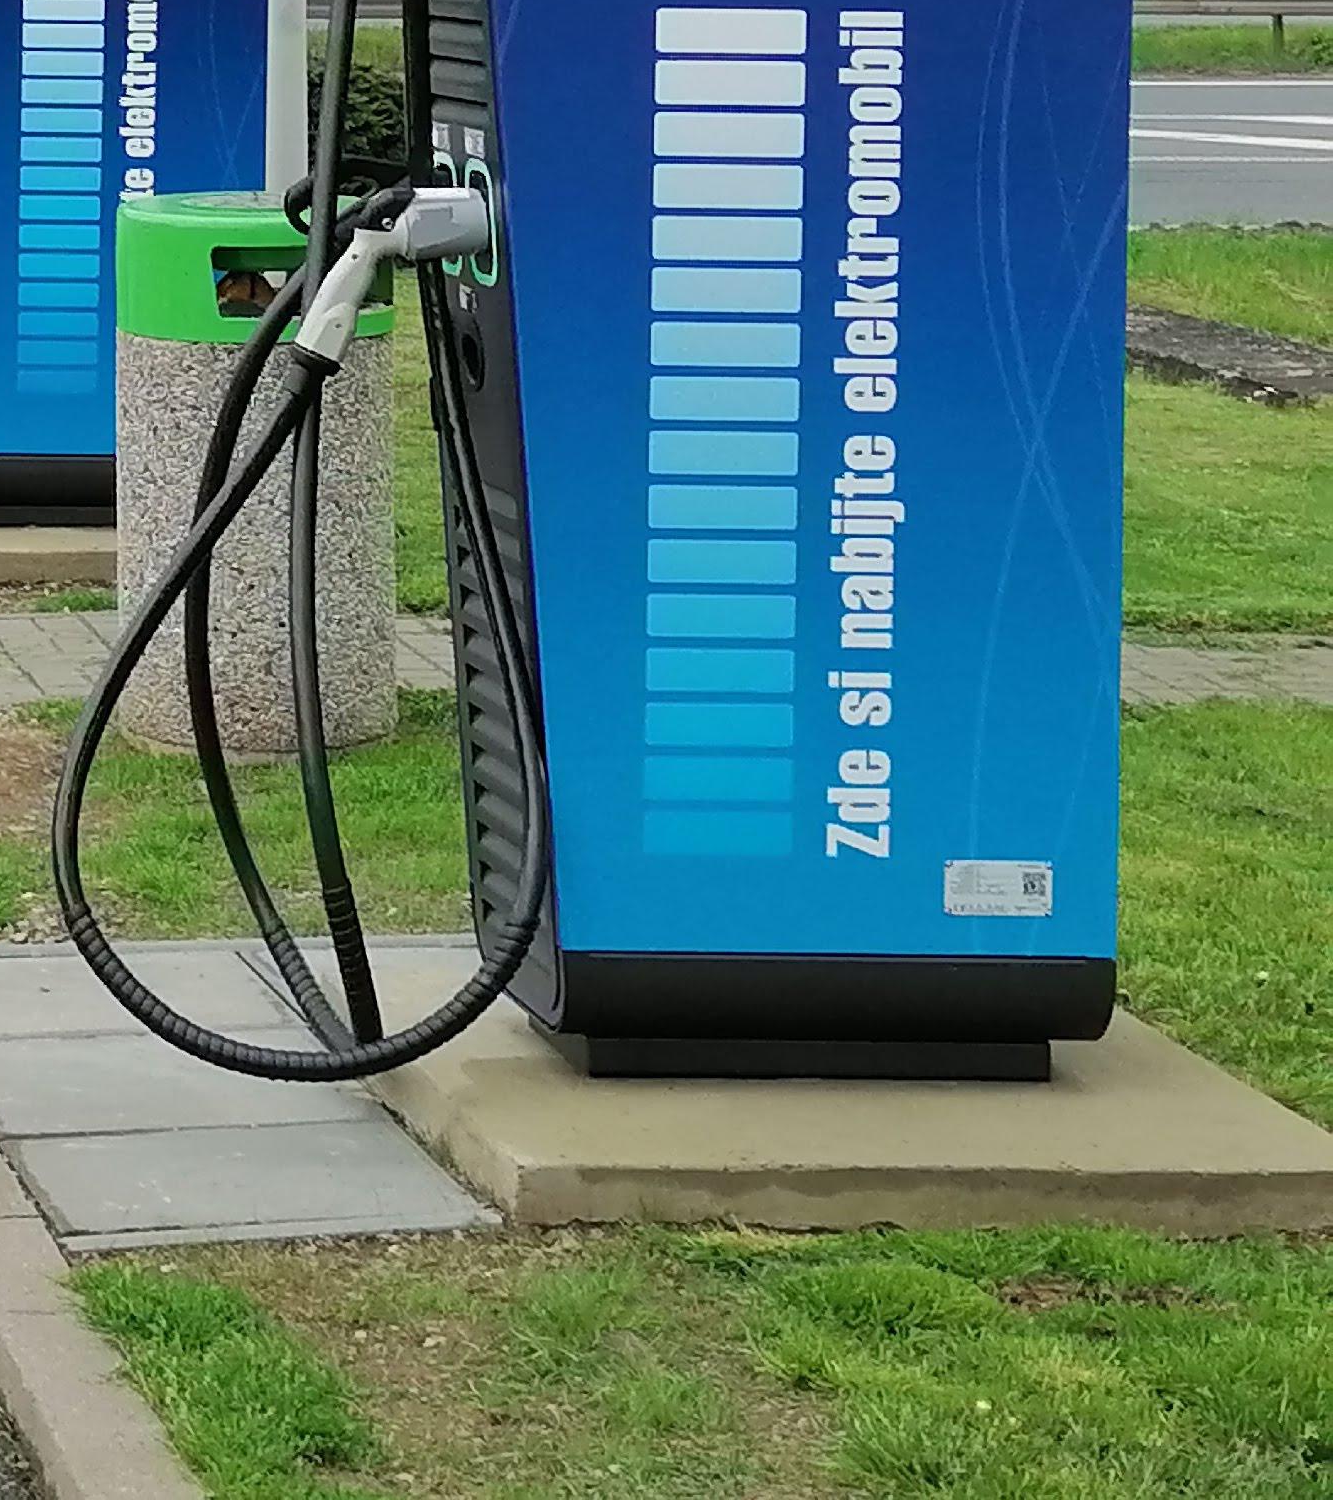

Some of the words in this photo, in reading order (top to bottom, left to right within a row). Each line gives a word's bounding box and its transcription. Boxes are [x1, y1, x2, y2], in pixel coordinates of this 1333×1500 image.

[832, 10, 904, 412] elektromobil
[829, 434, 905, 650] nabijte
[827, 670, 893, 727] si
[825, 748, 892, 859] Zde
